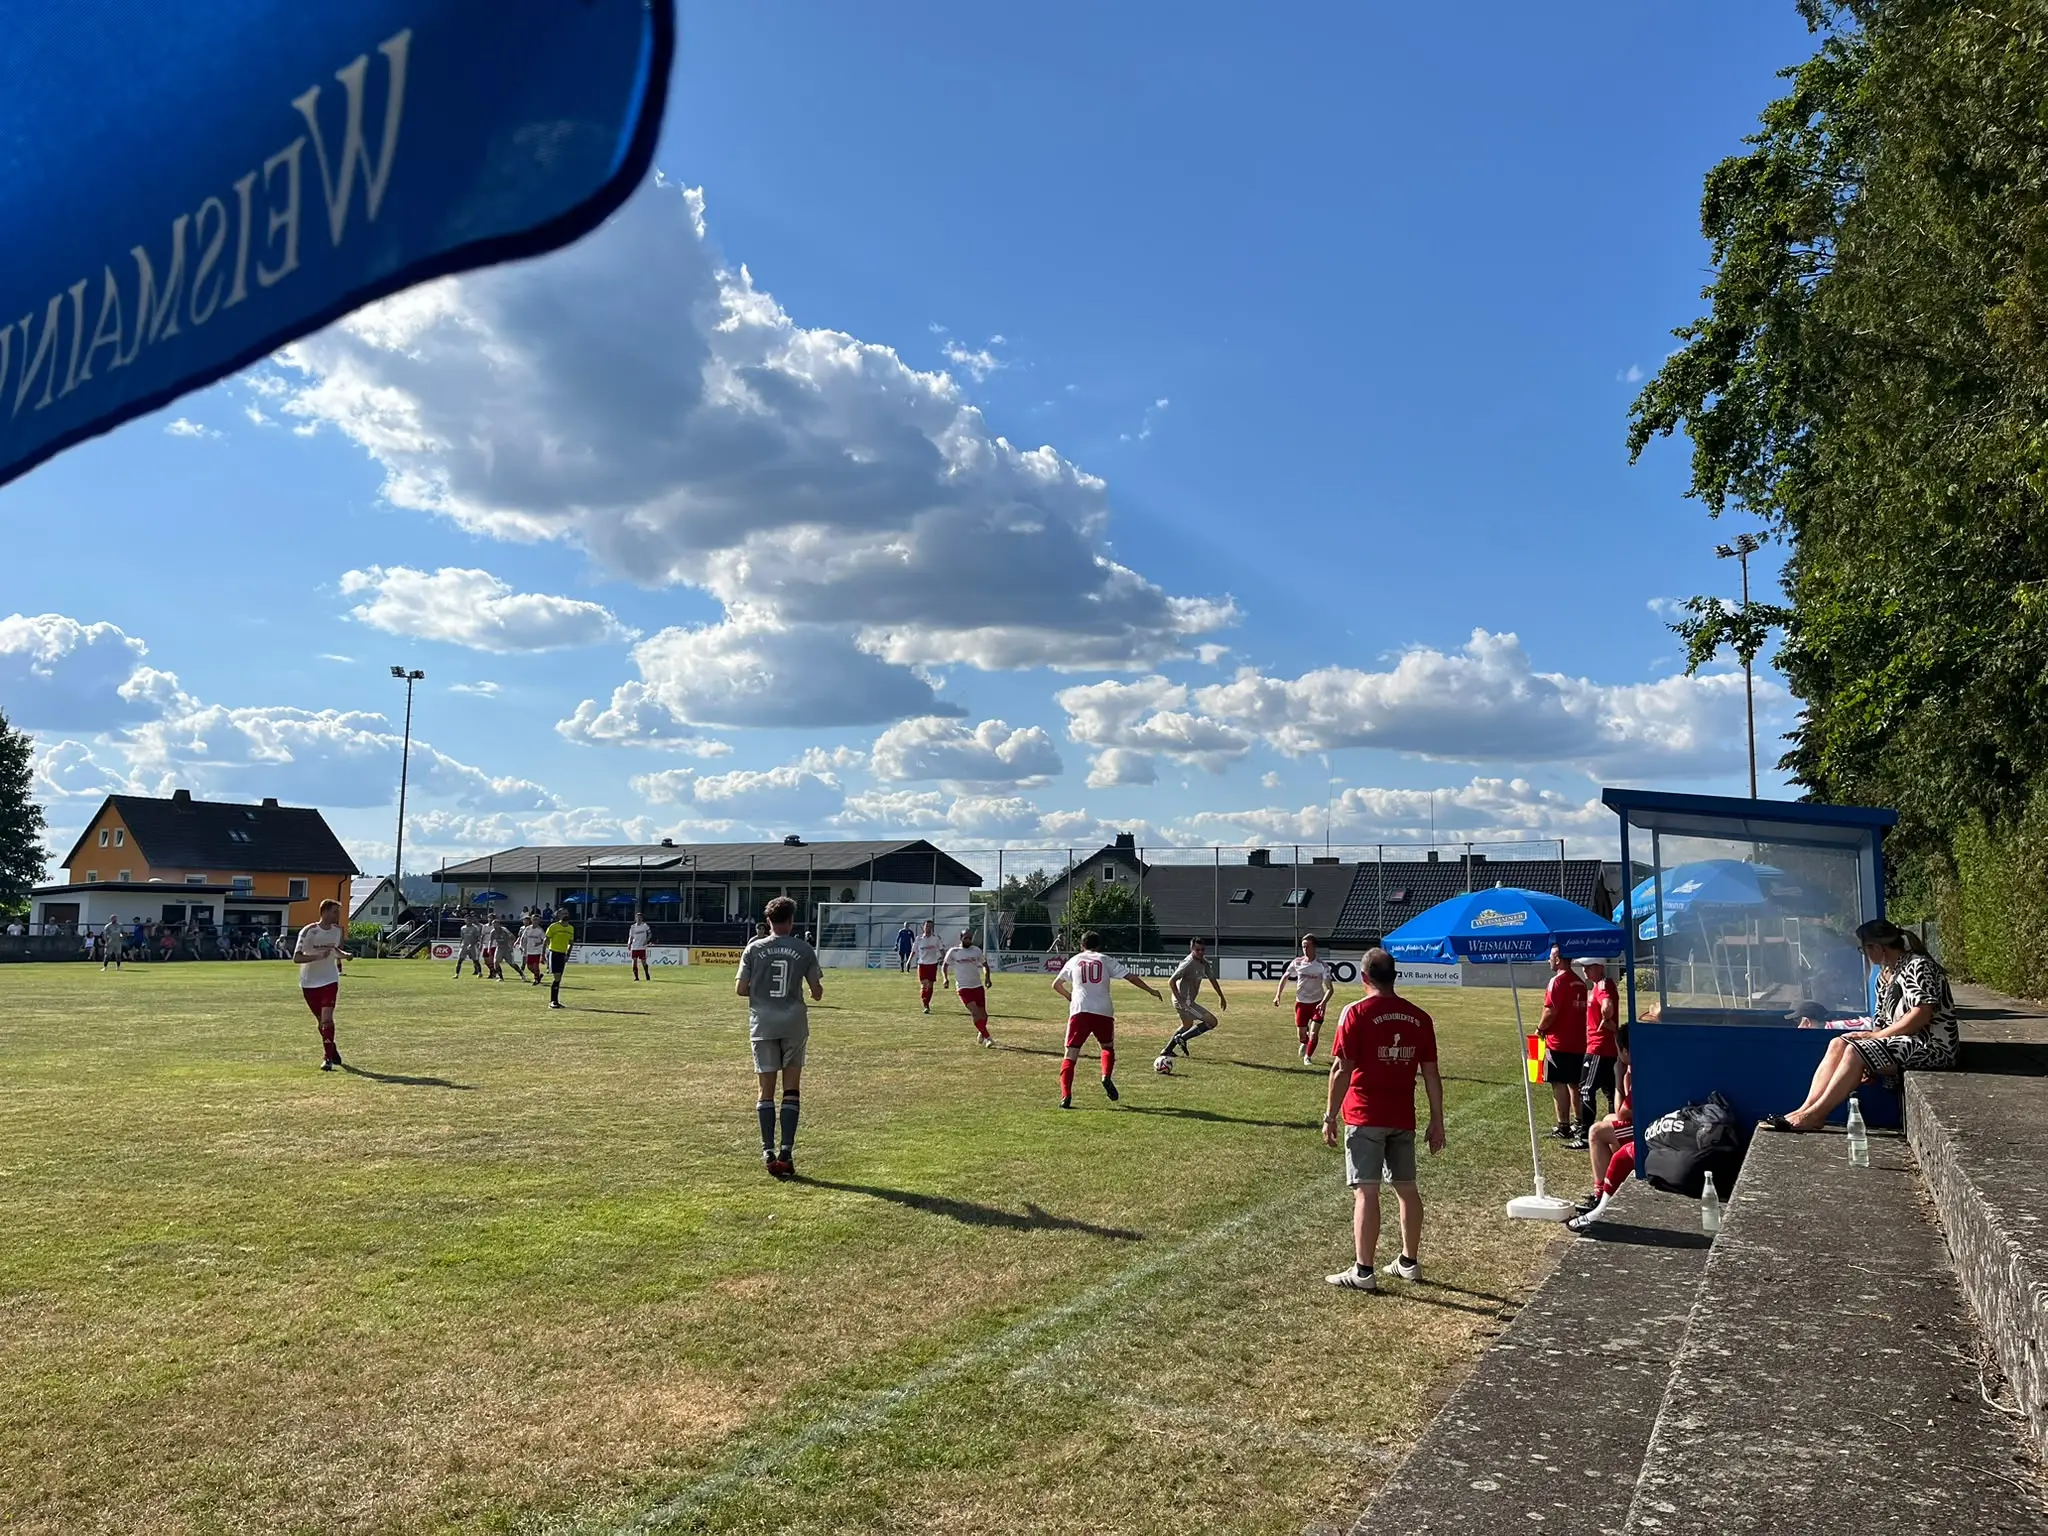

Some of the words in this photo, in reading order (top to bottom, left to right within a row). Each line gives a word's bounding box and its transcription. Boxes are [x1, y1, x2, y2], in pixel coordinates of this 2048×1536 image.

[1475, 914, 1525, 926] WEISMAINER
[1468, 940, 1532, 952] WEISMAINER
[769, 960, 788, 997] 3
[1079, 960, 1103, 984] 10
[1153, 965, 1178, 977] Gmb
[1247, 960, 1357, 982] RECRO
[1434, 972, 1447, 980] Hof
[1644, 1117, 1685, 1141] adidas
